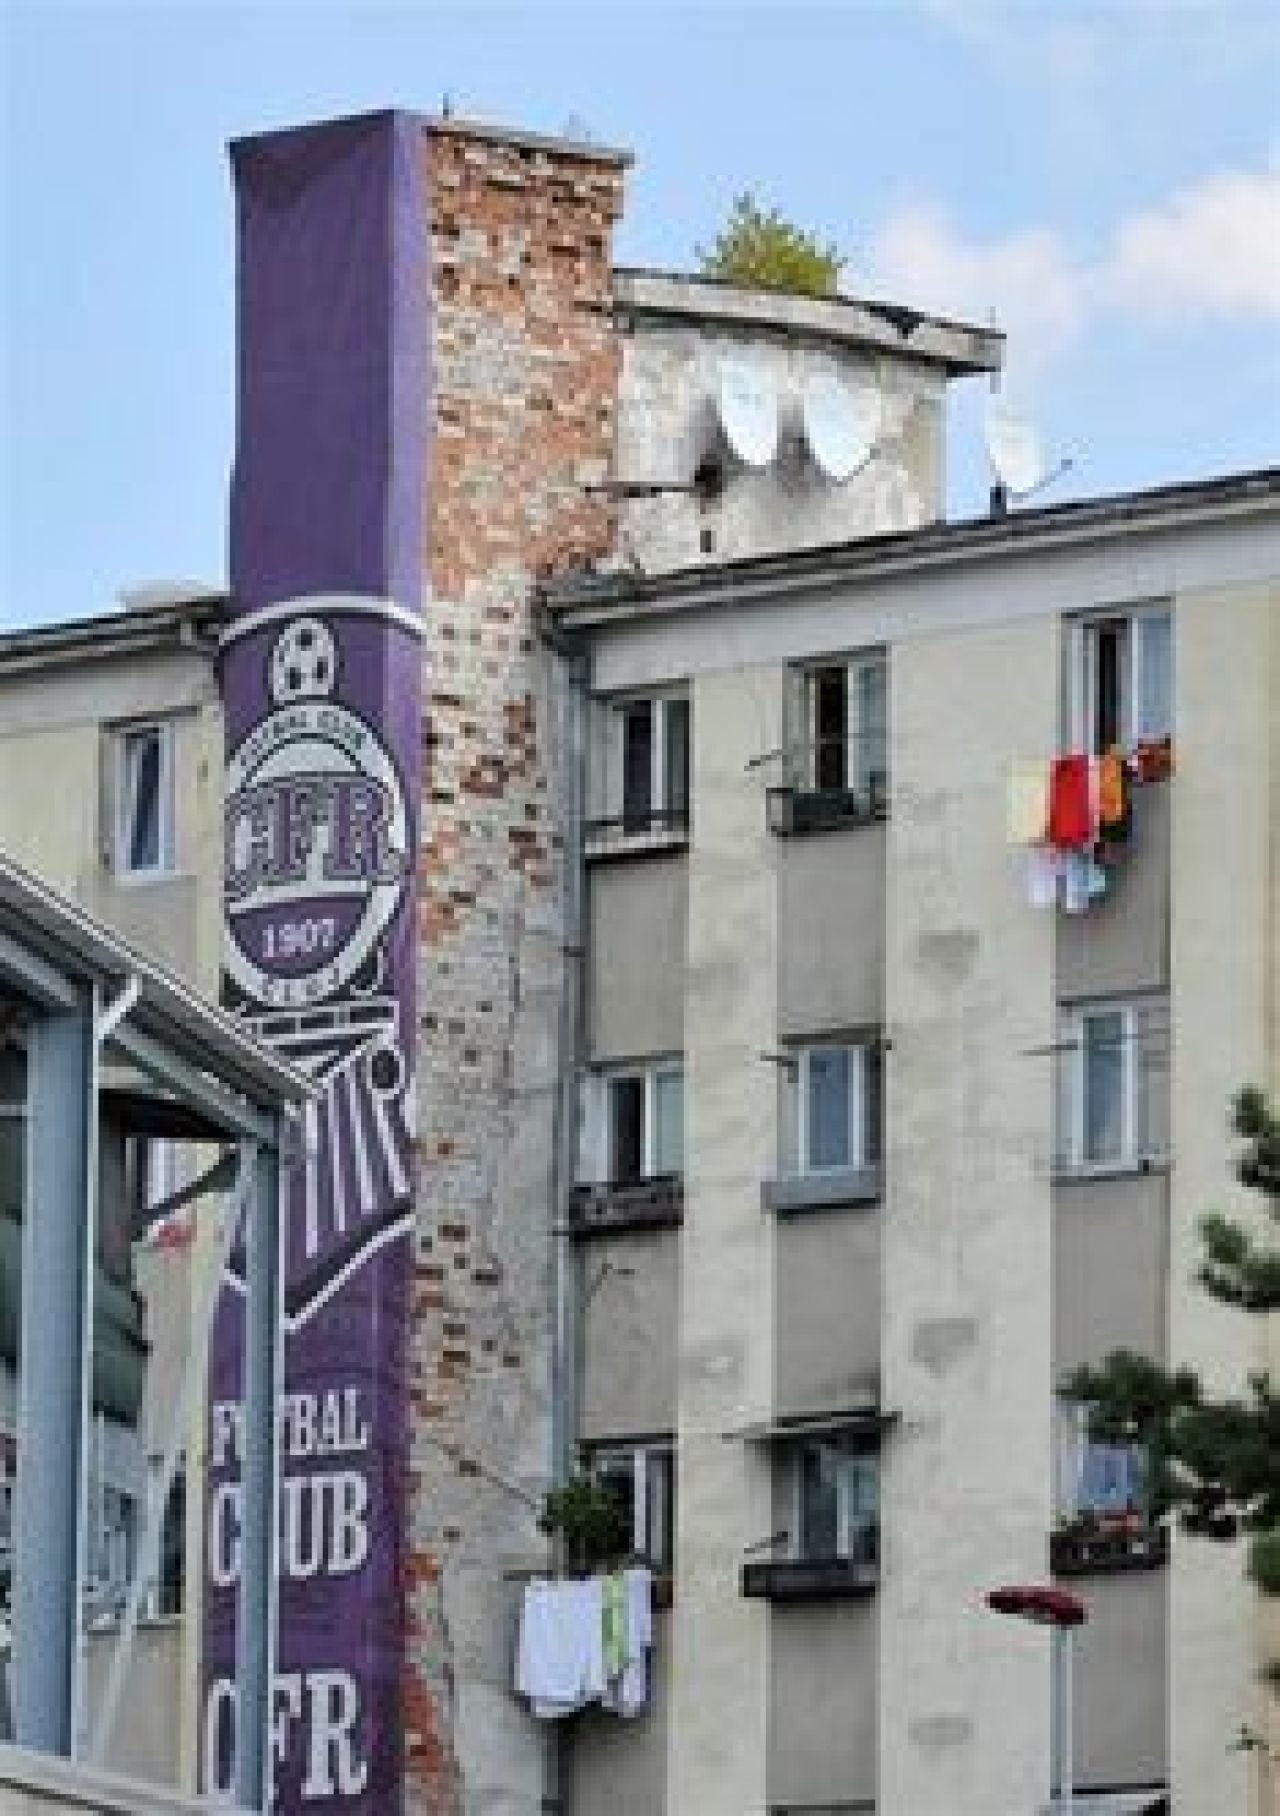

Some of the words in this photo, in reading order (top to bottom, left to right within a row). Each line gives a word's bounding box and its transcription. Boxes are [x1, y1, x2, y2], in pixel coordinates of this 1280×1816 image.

[262, 917, 337, 959] 1907
[212, 1387, 369, 1467] FBAL
[210, 1471, 369, 1588] CUB
